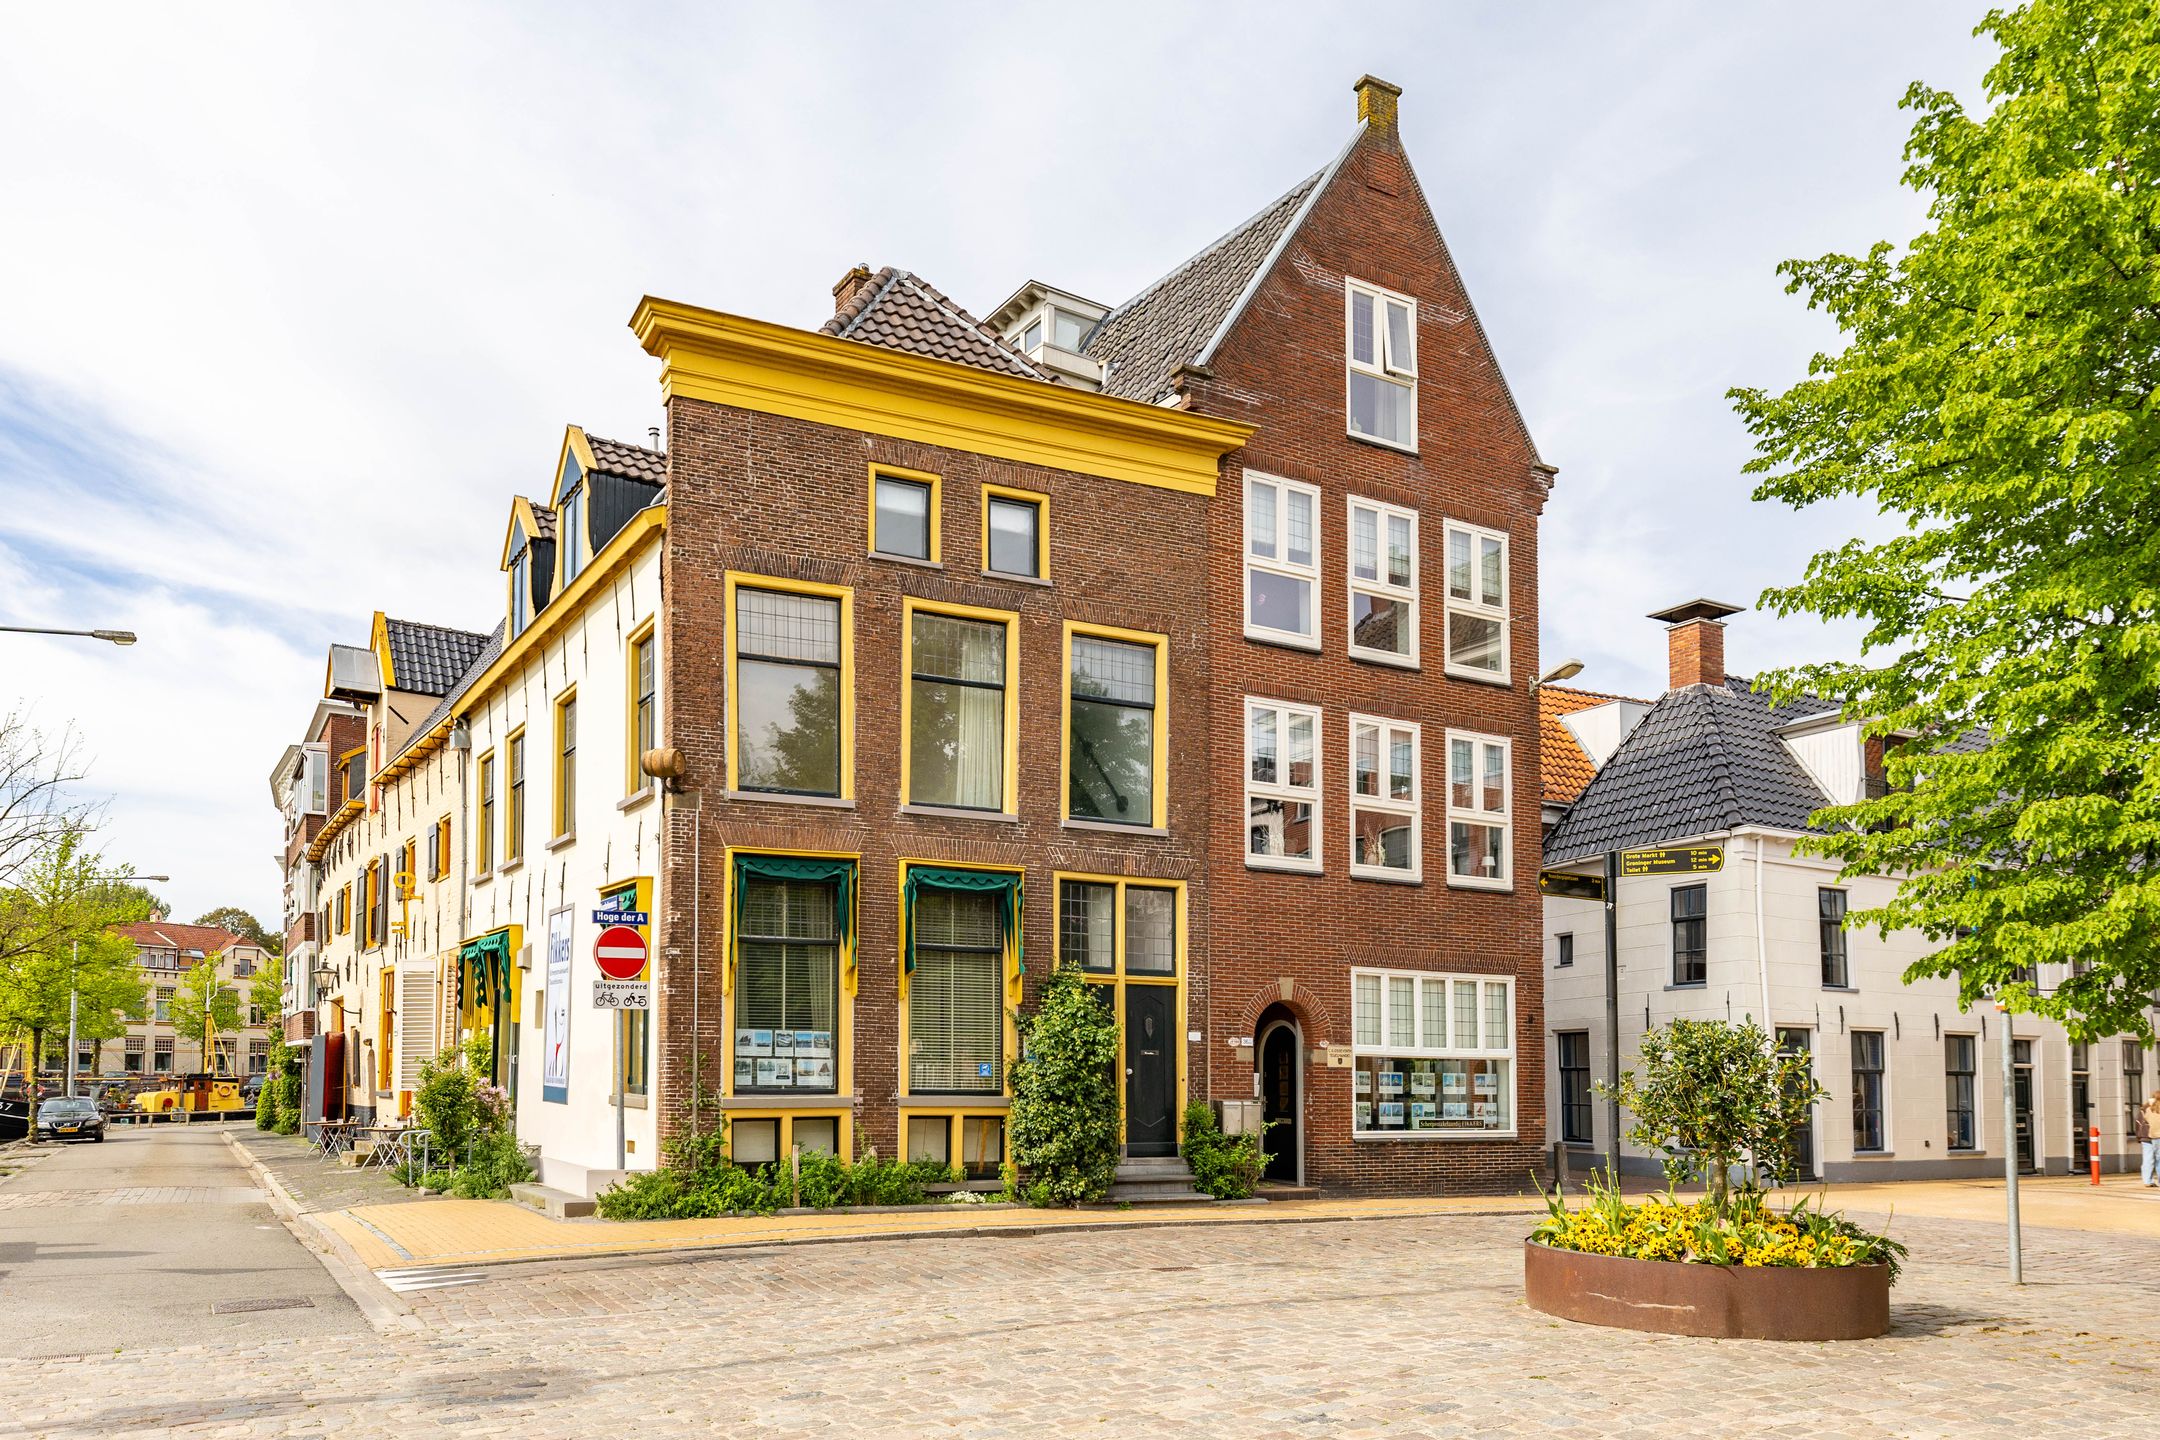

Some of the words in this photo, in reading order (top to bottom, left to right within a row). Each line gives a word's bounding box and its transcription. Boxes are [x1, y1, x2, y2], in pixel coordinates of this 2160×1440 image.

[597, 912, 619, 922] Hoge
[621, 913, 635, 922] der
[637, 913, 644, 922] A
